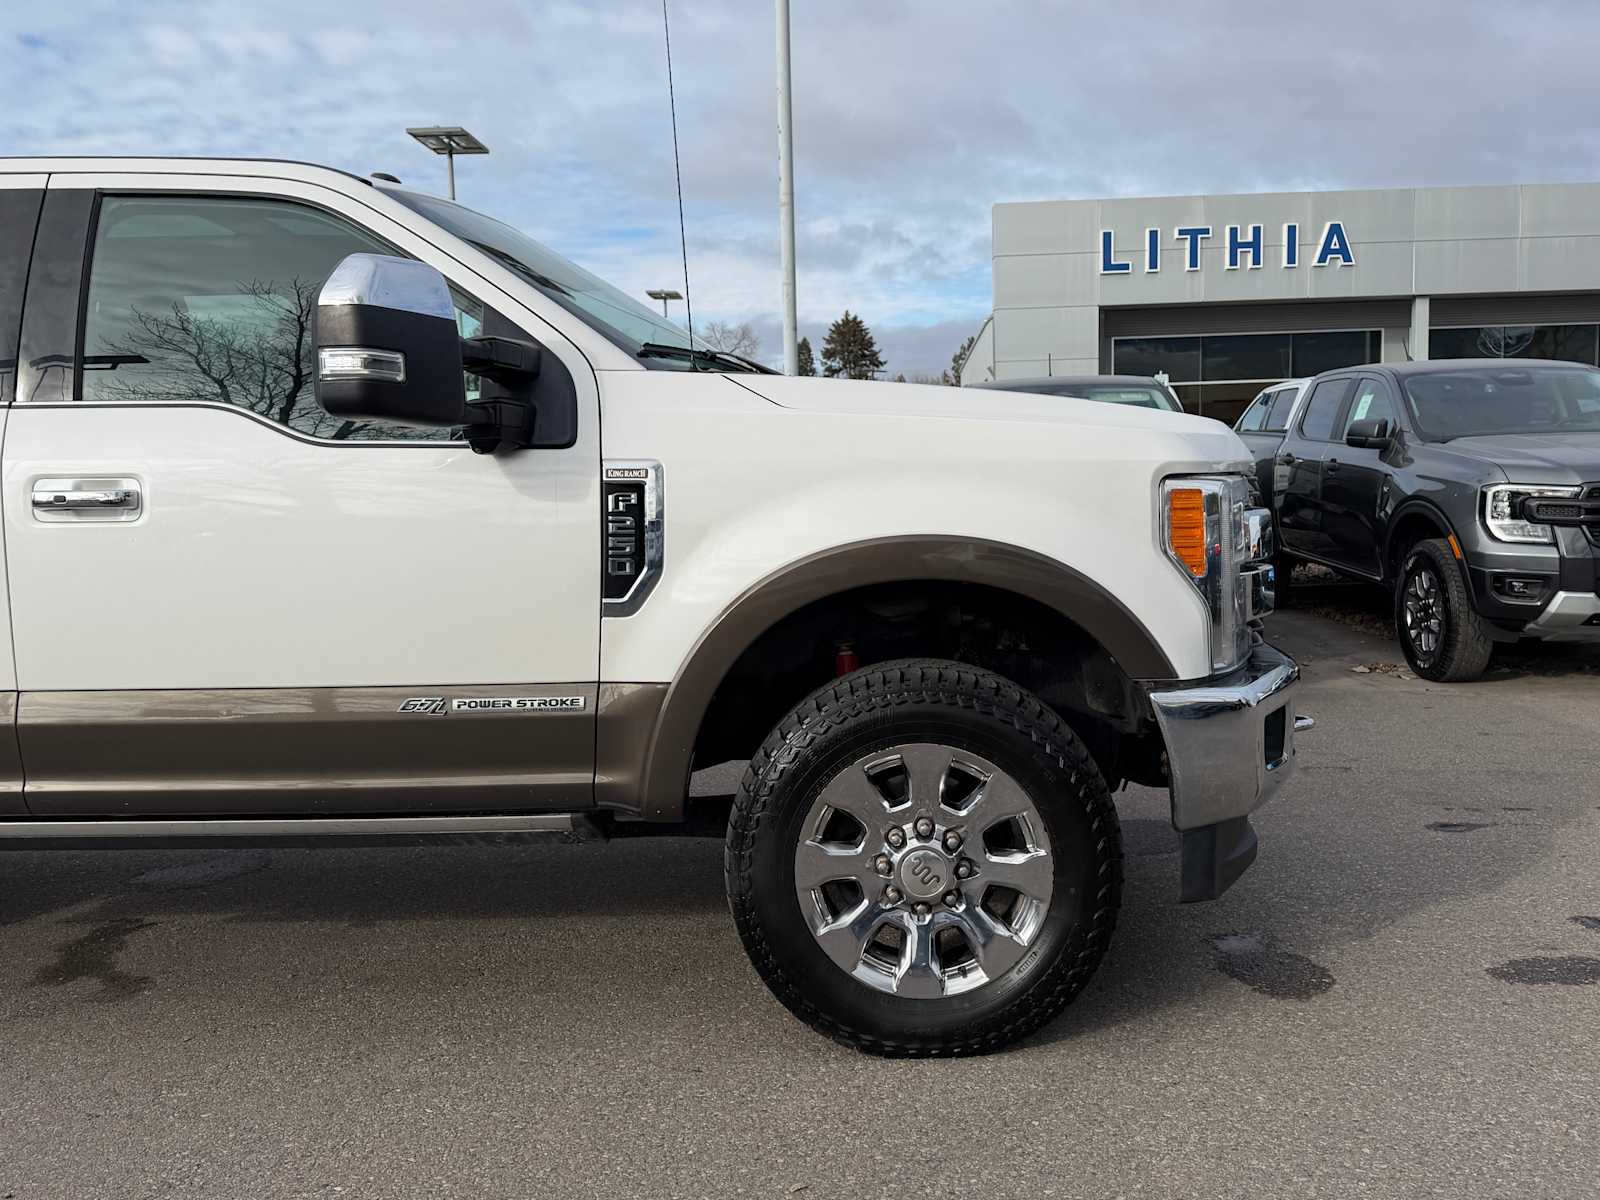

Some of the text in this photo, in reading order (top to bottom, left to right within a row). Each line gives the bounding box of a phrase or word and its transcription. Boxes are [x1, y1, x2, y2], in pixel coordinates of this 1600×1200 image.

[1100, 221, 1355, 274] LITHIA
[607, 469, 646, 478] KING RANCH
[456, 700, 511, 708] POWER
[516, 698, 580, 707] STROKE
